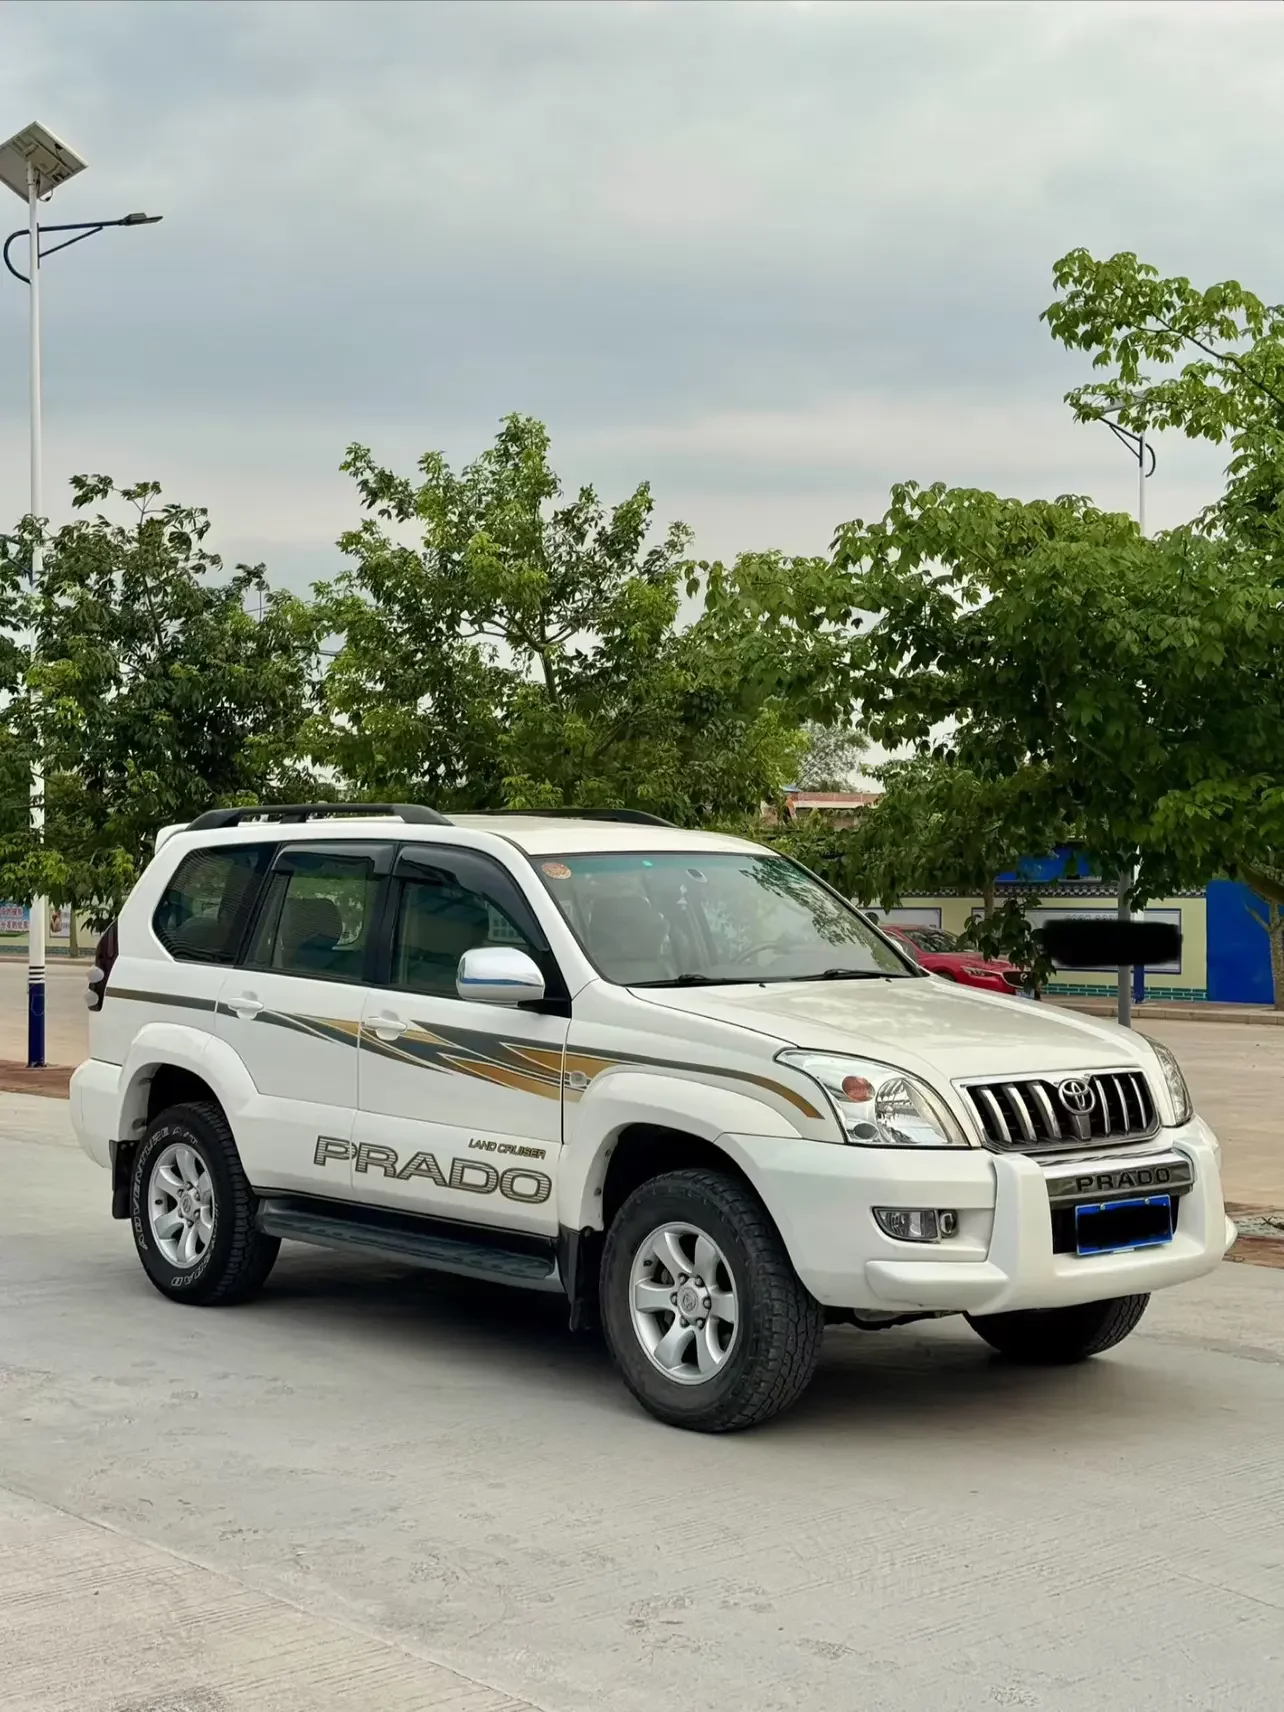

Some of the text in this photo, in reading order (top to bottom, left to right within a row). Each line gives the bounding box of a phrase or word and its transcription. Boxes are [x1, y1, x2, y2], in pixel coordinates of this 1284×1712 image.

[313, 1135, 553, 1205] PRADO
[468, 1138, 546, 1160] LAND CRUISER
[132, 1126, 199, 1251] ADVENTURE A/T
[1075, 1167, 1171, 1192] PRADO
